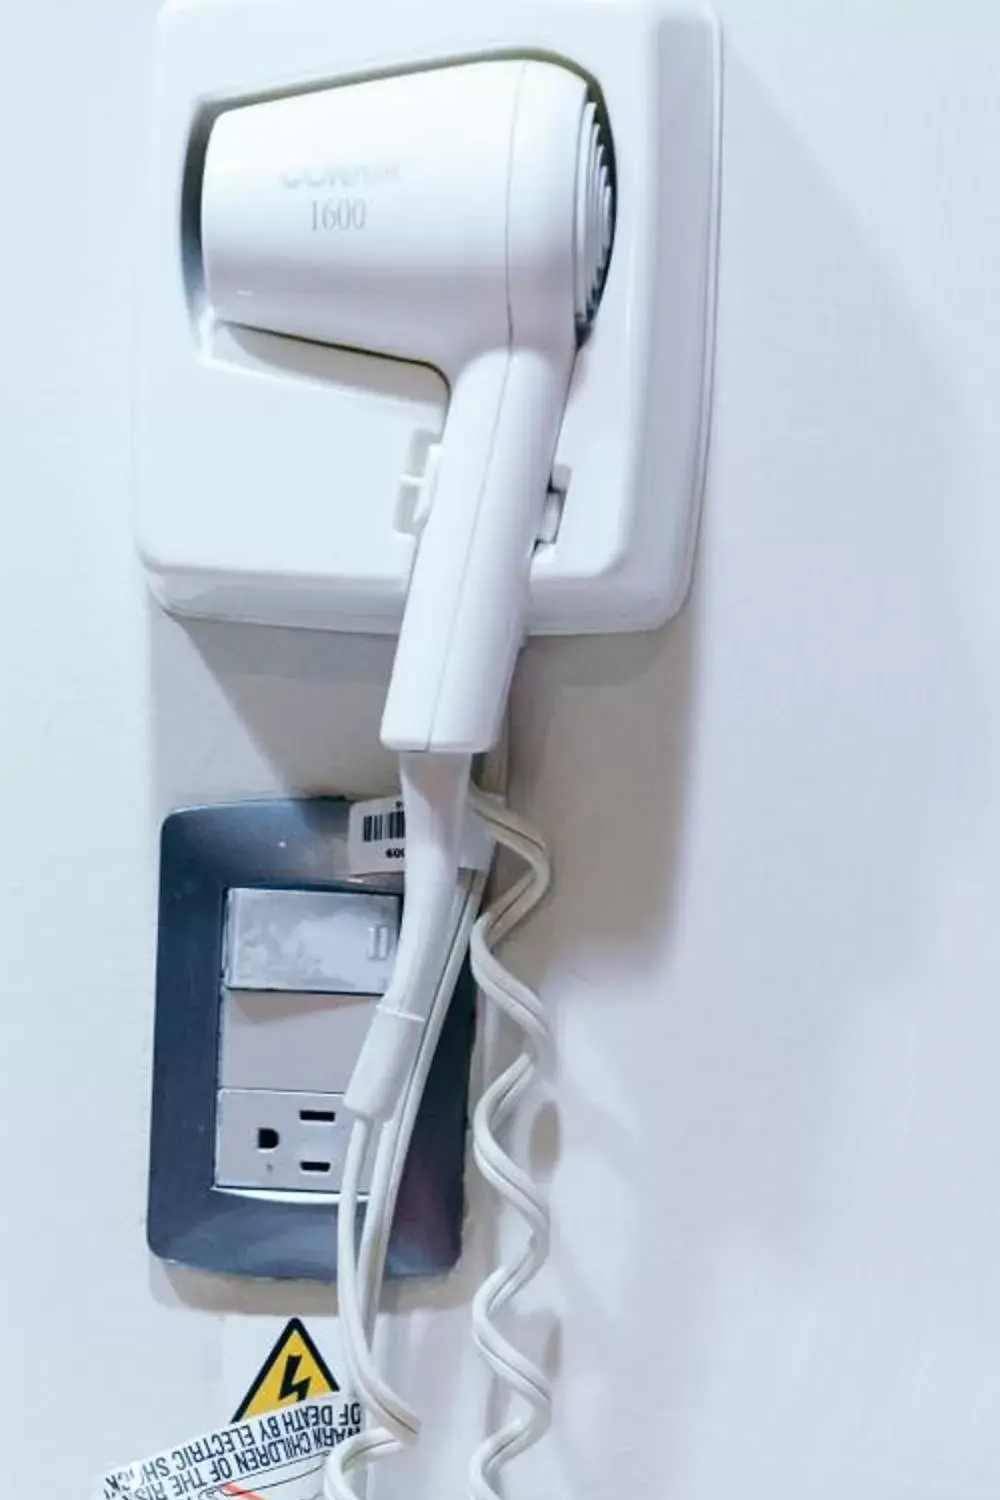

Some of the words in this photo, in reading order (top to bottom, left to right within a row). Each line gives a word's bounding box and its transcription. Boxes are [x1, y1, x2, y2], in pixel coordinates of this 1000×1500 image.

[310, 198, 367, 232] 1600
[259, 1416, 281, 1442] BY
[282, 1404, 332, 1436] DEATH
[339, 1402, 361, 1426] OF
[172, 1425, 255, 1471] ELECTRIC
[234, 1432, 312, 1474] CHILDREN
[169, 1467, 207, 1496] THE
[209, 1458, 232, 1483] OF
